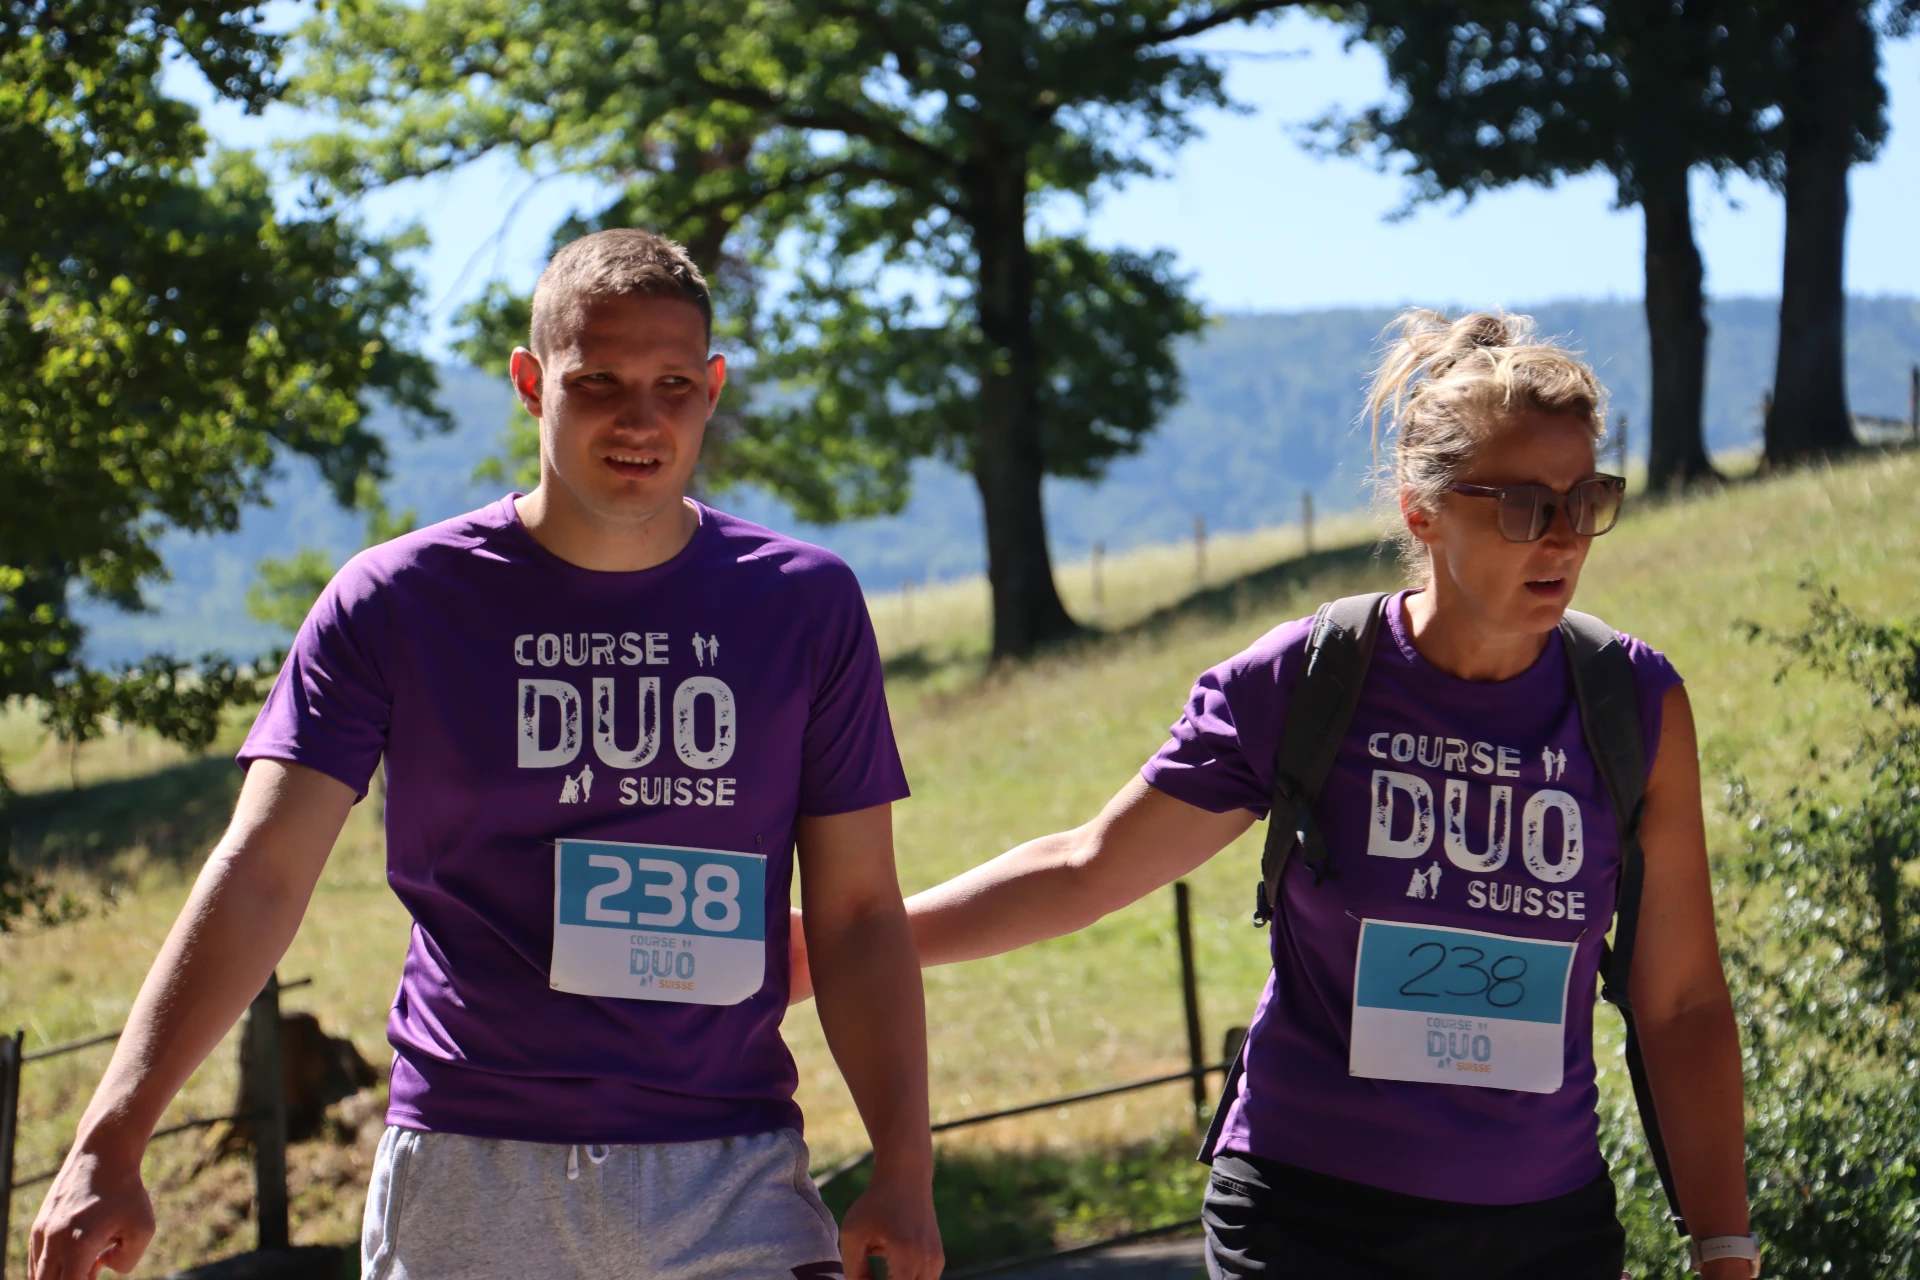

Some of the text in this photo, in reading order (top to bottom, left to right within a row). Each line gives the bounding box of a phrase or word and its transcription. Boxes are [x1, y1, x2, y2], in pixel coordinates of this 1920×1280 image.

[514, 631, 669, 667] COURSE
[517, 675, 737, 770] DUO
[1368, 732, 1522, 778] COURSE
[618, 776, 737, 807] SUISSE
[1366, 769, 1584, 883] DUO
[585, 854, 741, 932] 238
[1467, 880, 1586, 921] SUISSE
[629, 934, 676, 948] COURSE
[629, 947, 695, 980] DUO
[1399, 942, 1528, 1008] 238
[658, 979, 694, 991] SUISSE
[1426, 1017, 1473, 1031] COURSE
[1426, 1030, 1492, 1062] DUO
[1456, 1062, 1492, 1073] SUISSE
